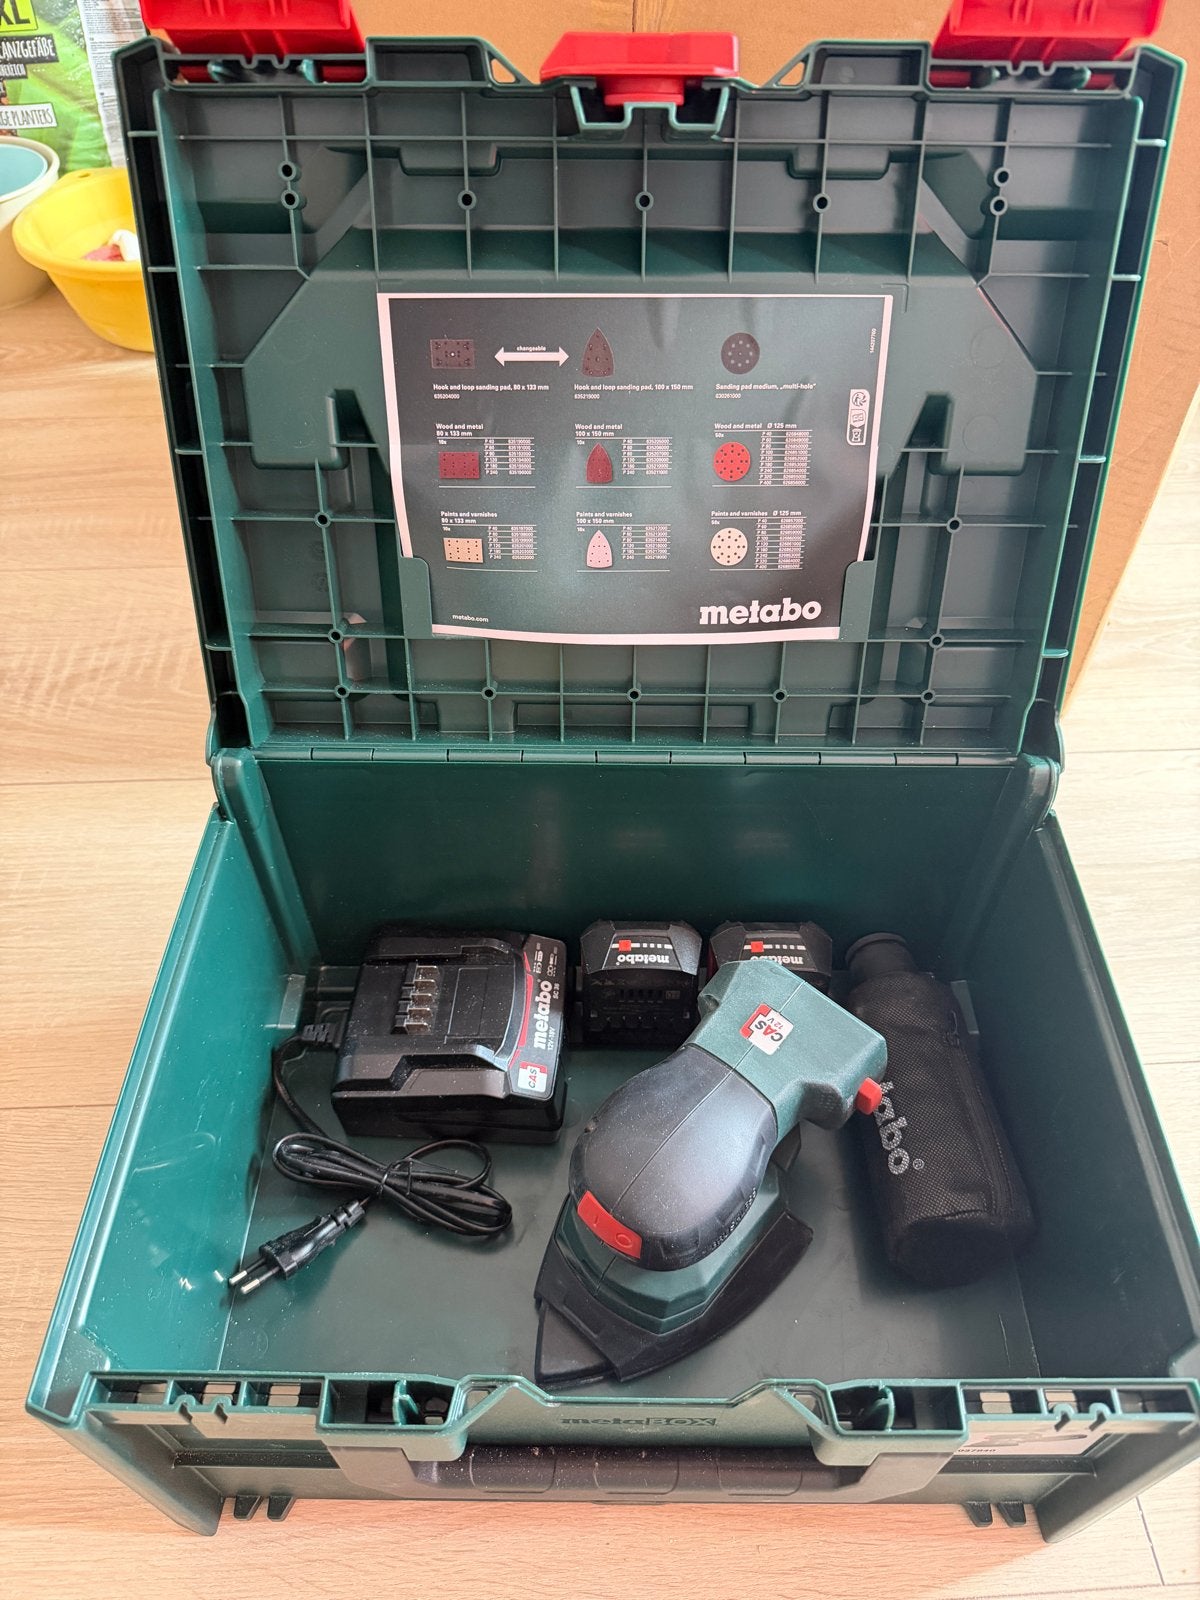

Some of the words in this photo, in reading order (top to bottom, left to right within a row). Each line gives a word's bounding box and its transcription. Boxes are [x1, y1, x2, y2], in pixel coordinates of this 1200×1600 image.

[11, 108, 53, 126] PLANTERS
[700, 598, 822, 624] metabo
[617, 954, 669, 964] metabo
[533, 980, 552, 1050] metabo
[754, 1020, 784, 1042] CAS
[528, 1068, 537, 1088] CAS
[560, 1418, 717, 1426] metaBOX
